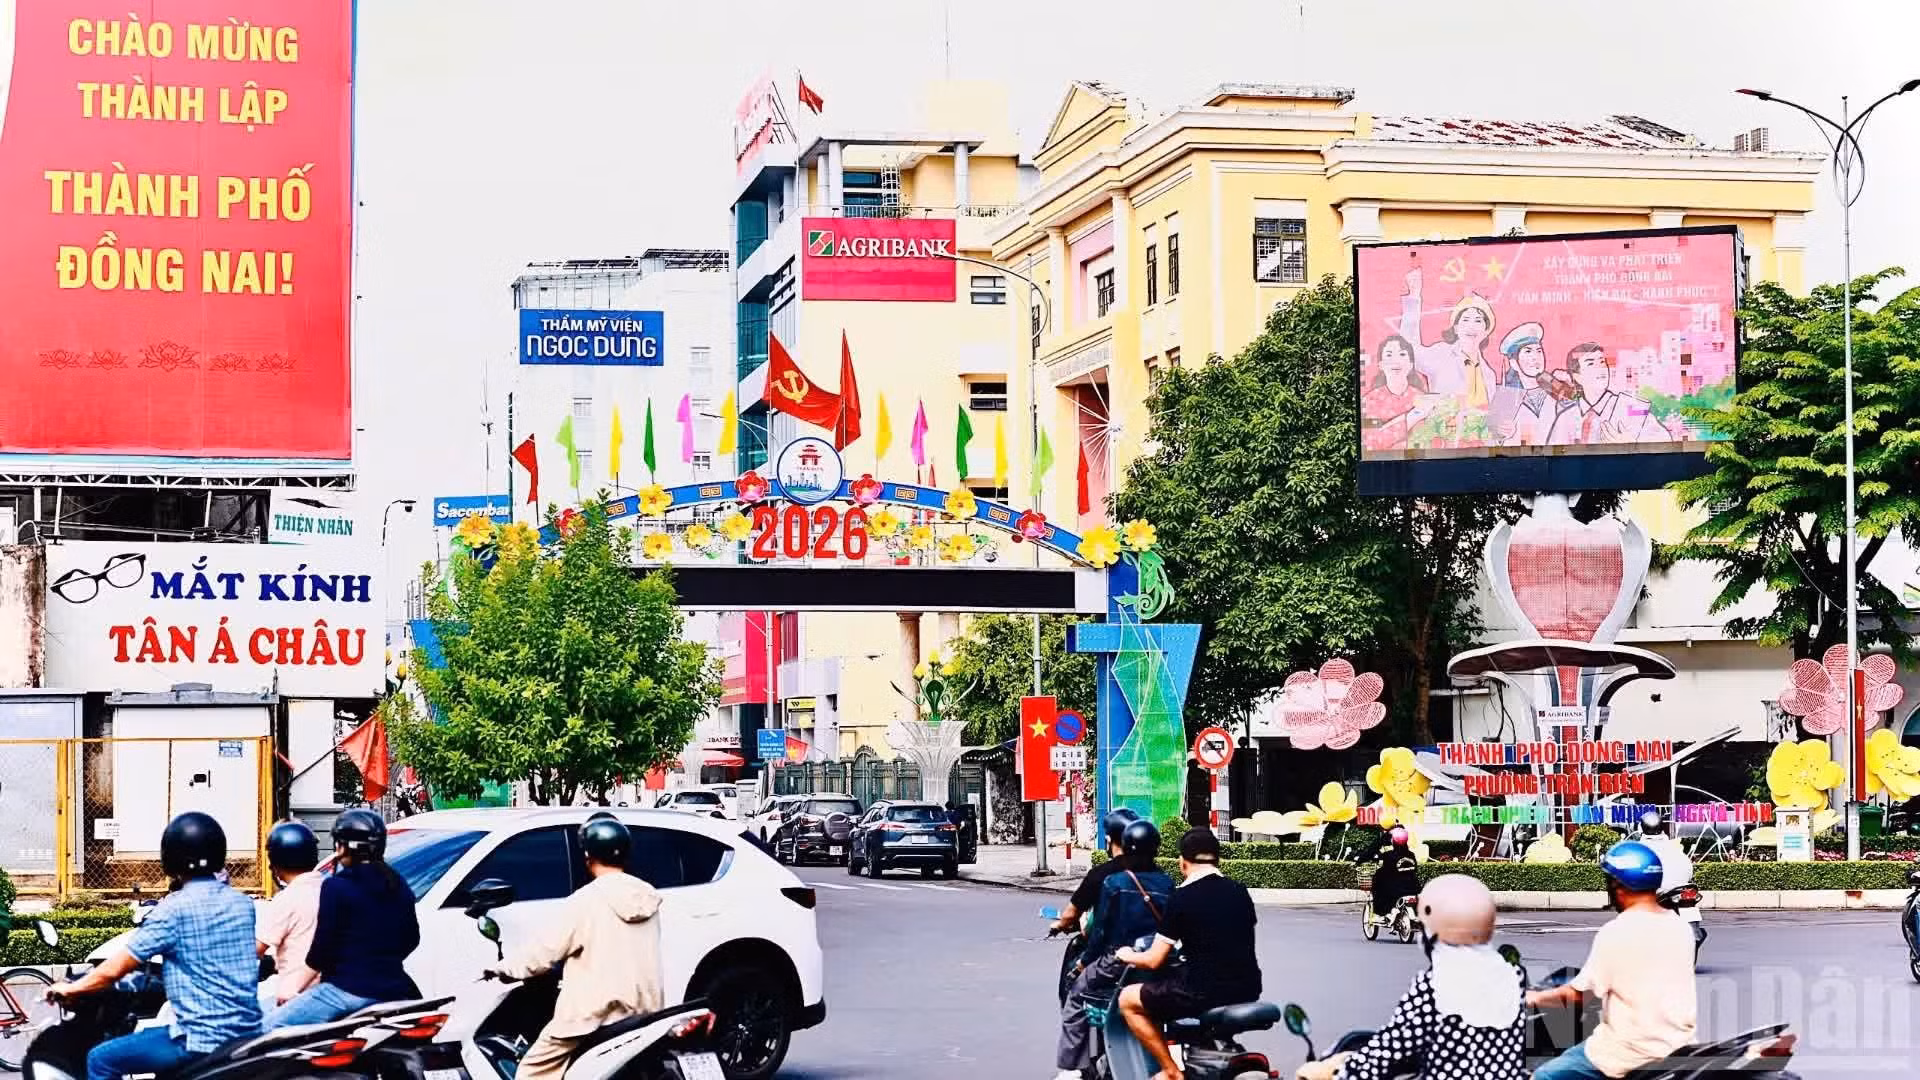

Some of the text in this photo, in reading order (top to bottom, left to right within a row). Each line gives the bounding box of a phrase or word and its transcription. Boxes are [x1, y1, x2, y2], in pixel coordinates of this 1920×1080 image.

[68, 12, 299, 63] CHÀO MỪNG
[77, 75, 288, 133] THÀNH LẬP
[44, 161, 315, 222] THÀNH PHỐ
[56, 231, 294, 296] ĐỒNG NAI!
[836, 237, 951, 258] AGRIBANK
[527, 335, 656, 358] NGỌC DUNG
[541, 314, 642, 334] THẨM MỸ VIỆN
[274, 512, 353, 536] THIỆN NHÂN
[752, 505, 868, 560] 2026
[150, 555, 371, 602] MẮT KÍNH
[109, 615, 367, 666] TÂN Á CHÂU
[1635, 738, 1672, 762] NAI
